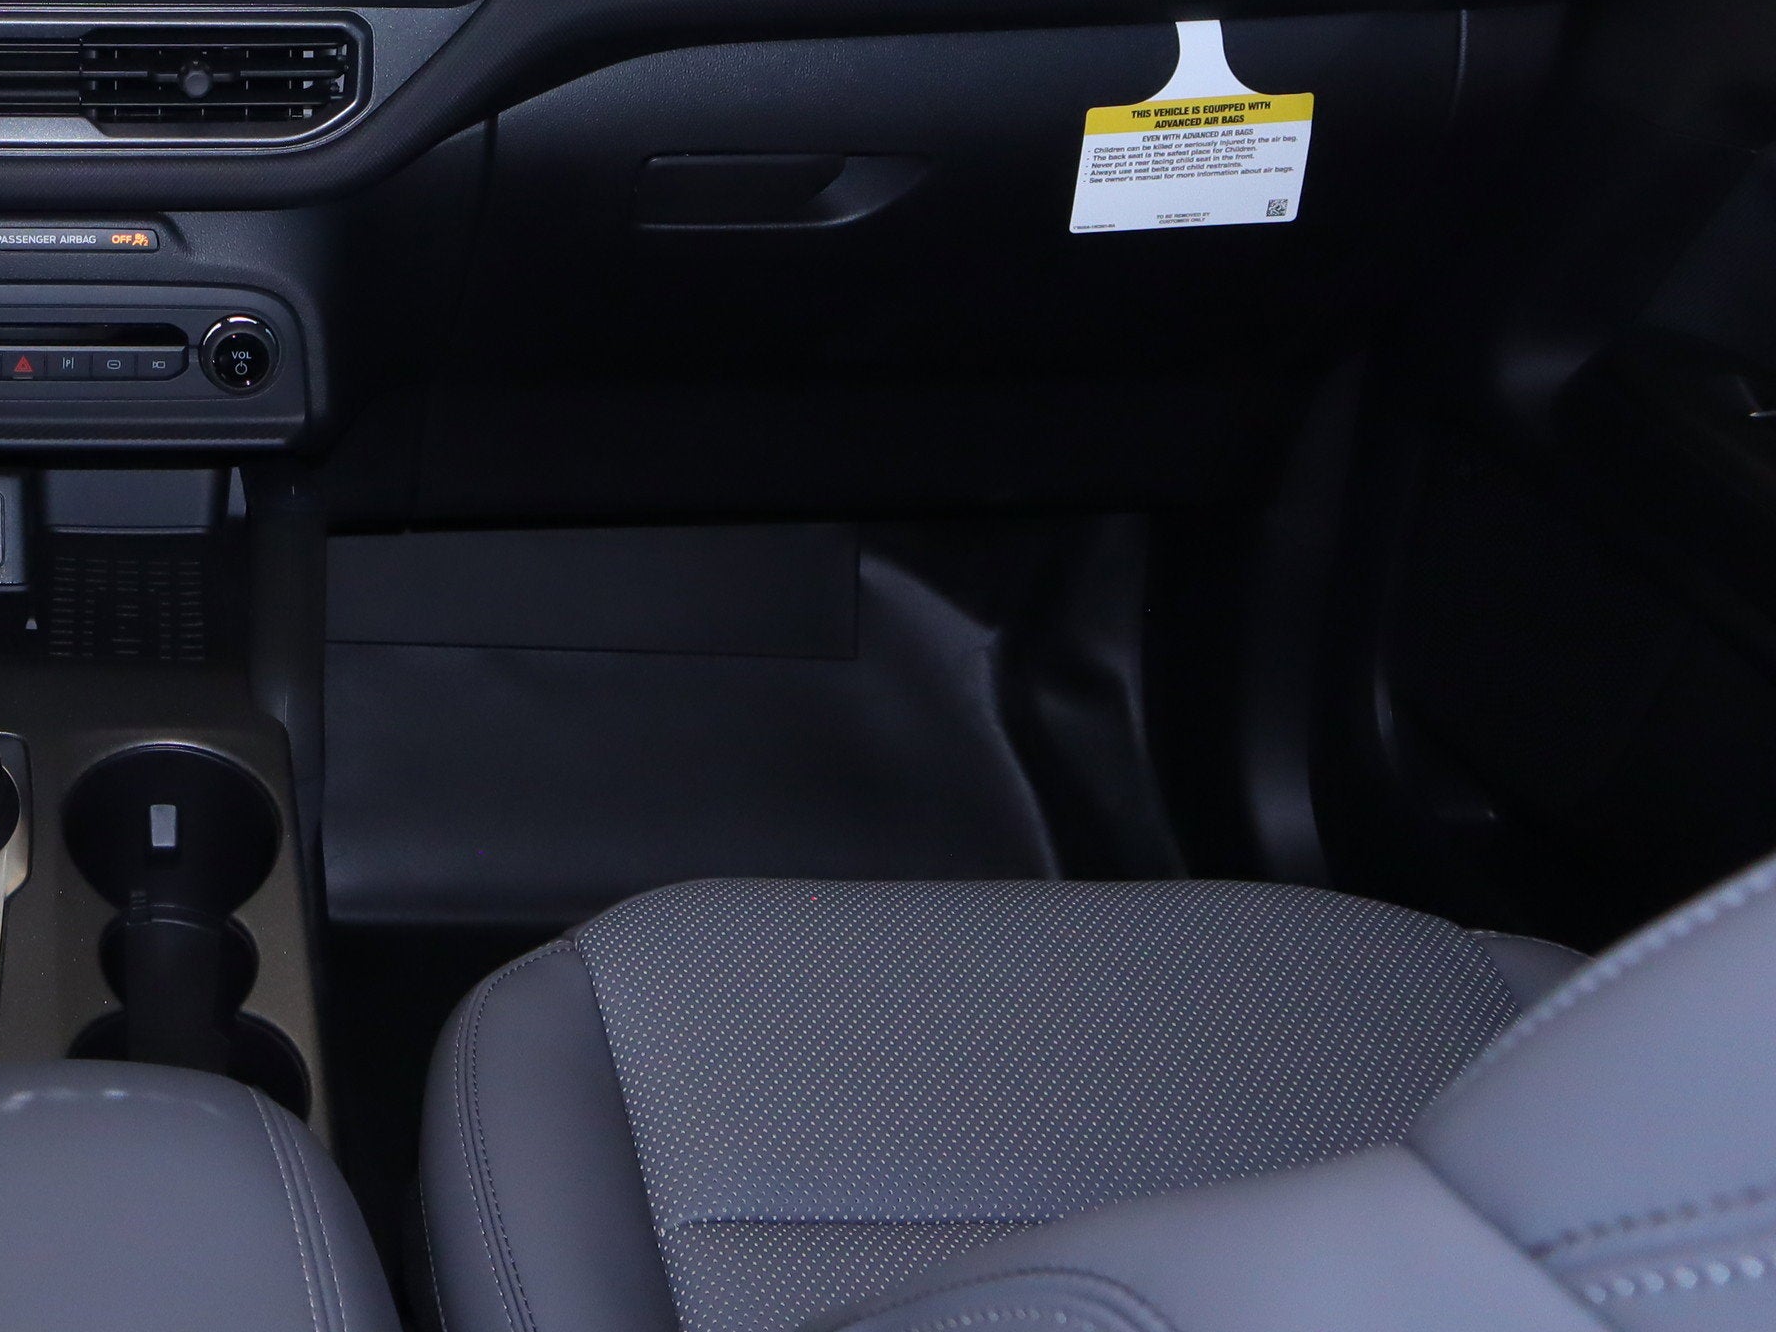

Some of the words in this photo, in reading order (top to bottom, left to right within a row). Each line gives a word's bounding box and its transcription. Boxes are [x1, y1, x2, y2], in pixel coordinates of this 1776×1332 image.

[1131, 109, 1151, 119] THIS
[1154, 107, 1189, 117] VEHICLE
[1192, 106, 1200, 114] IS
[1203, 103, 1245, 114] EQUIPPED
[1248, 101, 1271, 110] WITH
[1154, 118, 1202, 129] ADVANCED
[1203, 117, 1219, 125] AIR
[1221, 115, 1245, 124] BAGS
[1162, 133, 1181, 141] WITH
[1182, 130, 1219, 139] ADVANCED
[1221, 129, 1233, 137] AIR
[1234, 128, 1254, 136] BAGS
[1153, 142, 1173, 150] killed
[1184, 140, 1218, 148] seriously
[1219, 138, 1245, 147] injured
[1282, 135, 1298, 143] bag.
[1191, 148, 1211, 156] place
[1114, 161, 1127, 169] put
[1151, 158, 1174, 166] facing
[1105, 175, 1134, 183] owner's
[1197, 170, 1239, 178] information
[1274, 166, 1294, 174] bags.
[59, 235, 97, 244] AIRBAG
[111, 235, 132, 244] OFF
[231, 351, 252, 360] VOL
